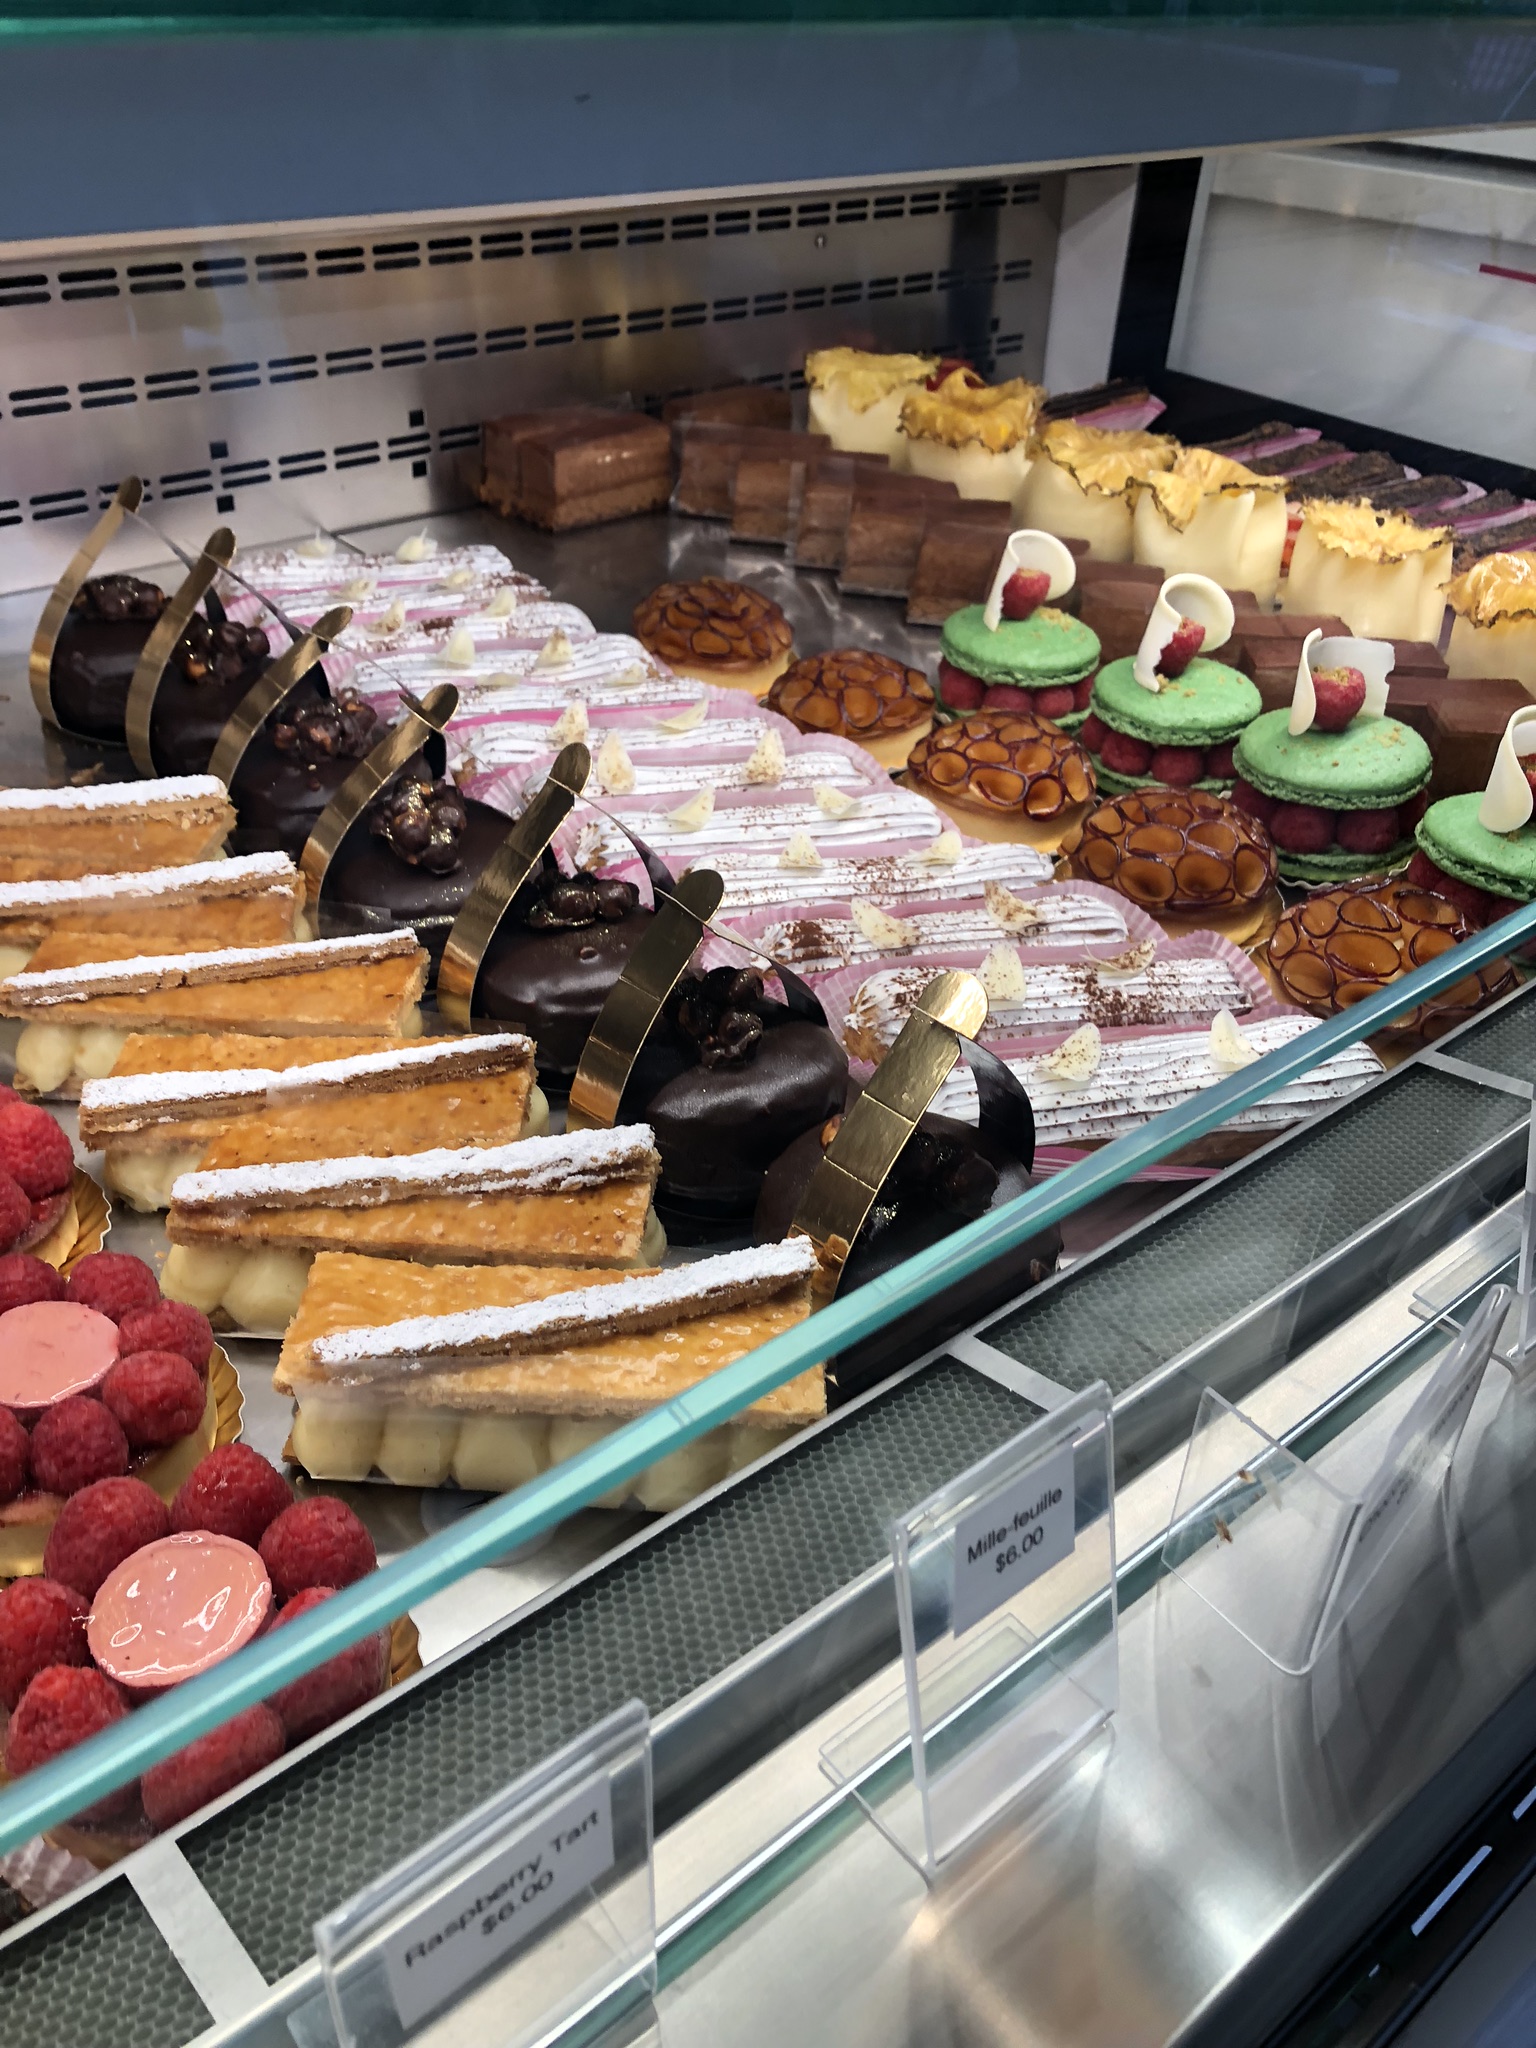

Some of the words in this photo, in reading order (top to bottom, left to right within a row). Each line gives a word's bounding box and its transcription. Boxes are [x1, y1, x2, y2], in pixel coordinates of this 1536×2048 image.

[967, 1488, 1063, 1564] Mille-feuille
[995, 1525, 1044, 1574] $6.00
[404, 1854, 543, 1969] Raspberry
[550, 1809, 600, 1854] Tart
[480, 1870, 554, 1937] $6.00
